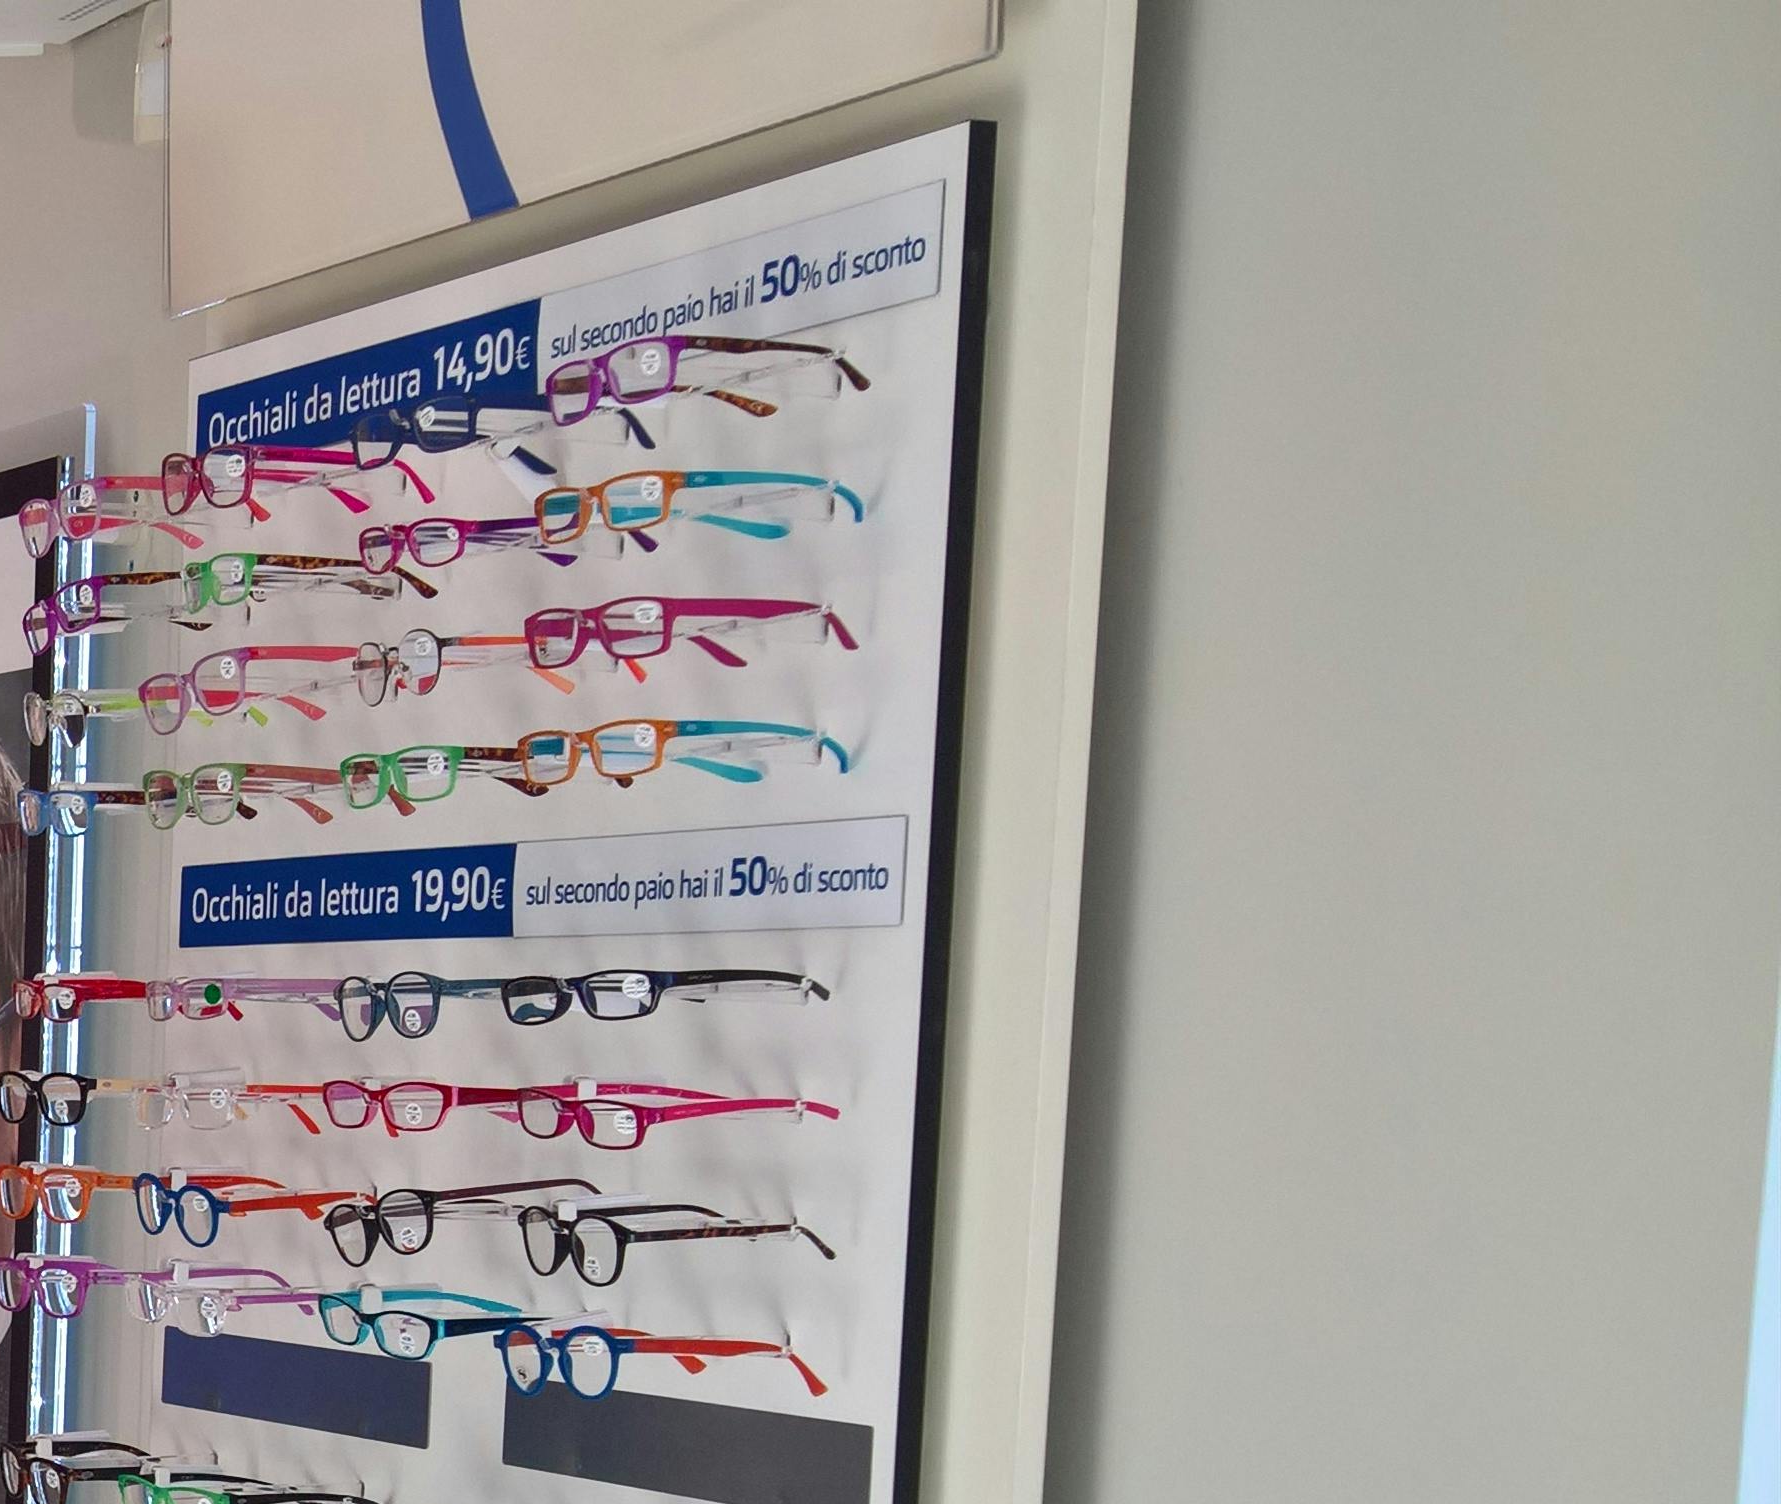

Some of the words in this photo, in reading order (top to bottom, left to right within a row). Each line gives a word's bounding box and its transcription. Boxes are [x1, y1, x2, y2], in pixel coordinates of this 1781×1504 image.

[551, 325, 576, 359] sul
[581, 304, 658, 350] secondo
[663, 294, 704, 337] paio
[709, 281, 739, 318] hai
[743, 274, 755, 308] il
[759, 254, 822, 303] 50%
[827, 251, 847, 285] di
[852, 235, 926, 280] sconto
[208, 390, 297, 448] Occhiali
[304, 383, 332, 425] da
[339, 367, 421, 416] lettura
[433, 328, 531, 393] 14,90€
[192, 882, 279, 923] Occhiali
[285, 880, 312, 918] da
[320, 878, 399, 917] lettura
[411, 866, 506, 923] 19,90€
[526, 877, 551, 905] sul
[554, 873, 630, 905] secondo
[634, 872, 674, 910] paio
[679, 869, 708, 899] hai
[713, 867, 724, 898] il
[729, 855, 788, 896] 50%
[793, 863, 812, 894] di
[817, 862, 889, 892] sconto
